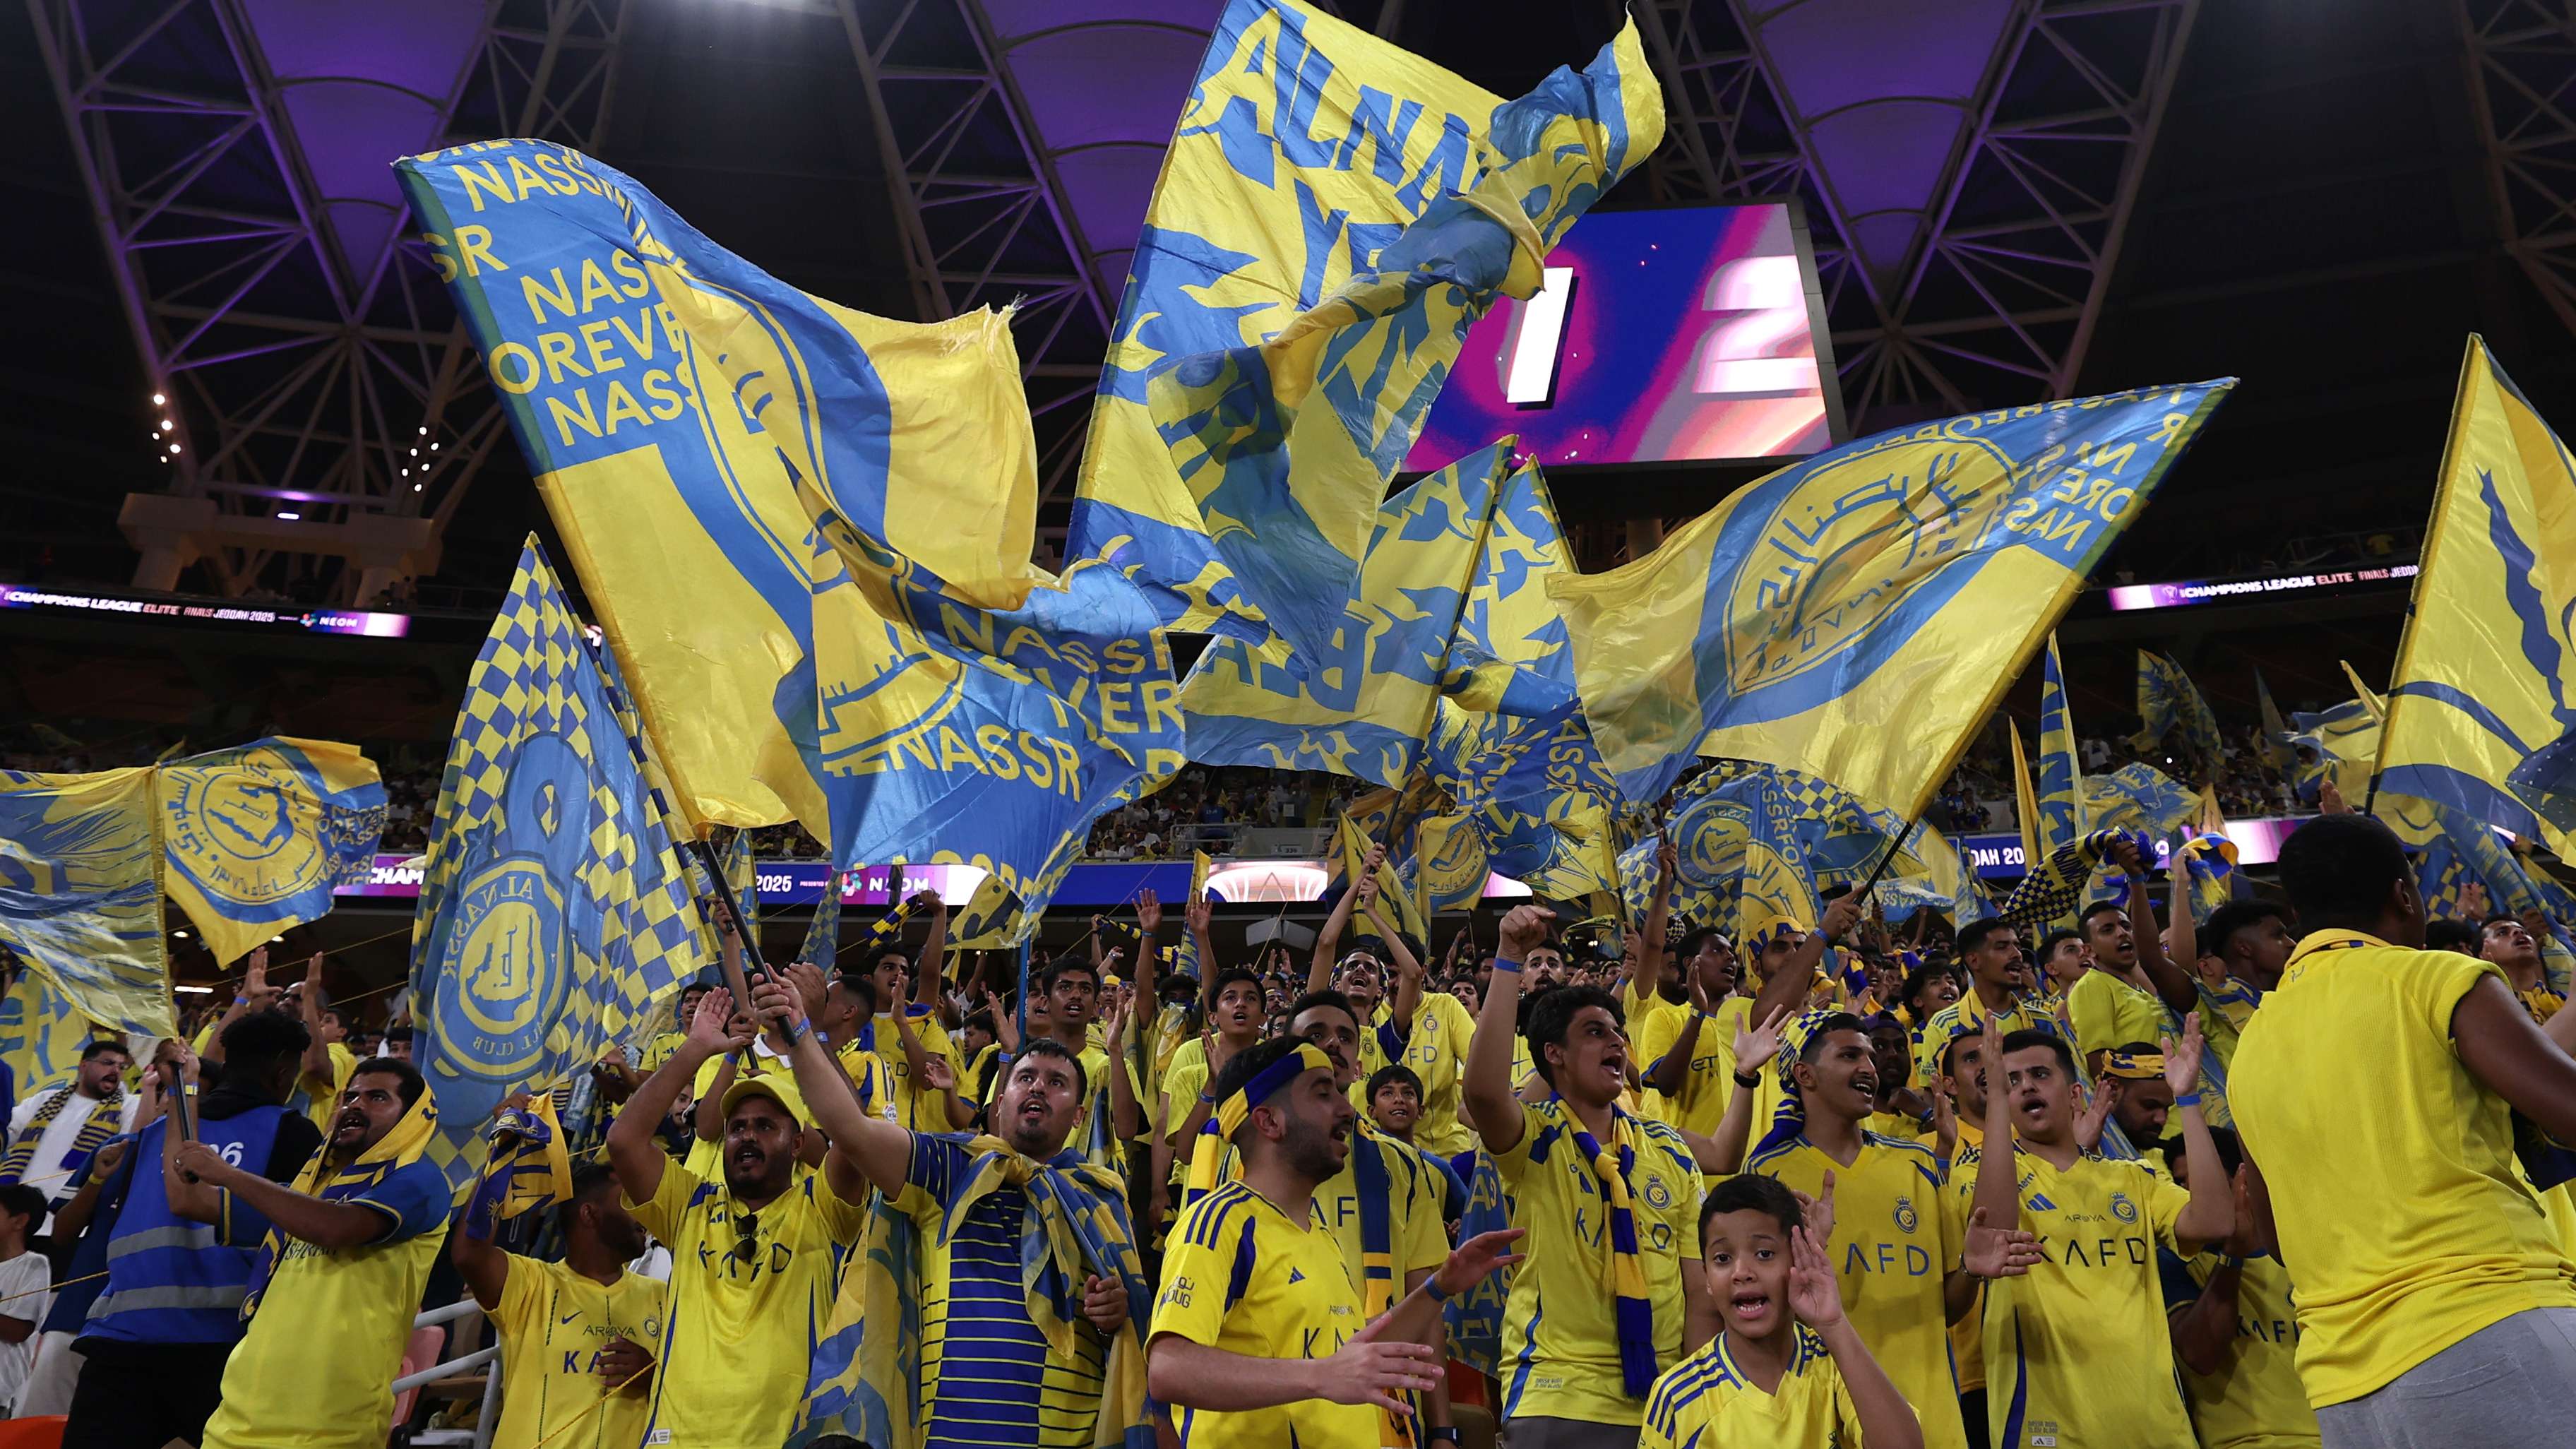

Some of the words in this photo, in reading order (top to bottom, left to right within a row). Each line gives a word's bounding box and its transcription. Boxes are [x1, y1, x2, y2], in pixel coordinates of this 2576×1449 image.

[2185, 581, 2264, 597] CHAMPIONS
[2264, 576, 2316, 591] LEAGUE
[2316, 572, 2354, 585] ELITE
[2359, 568, 2389, 580] FINALS
[8, 590, 91, 607] CHAMPIONS
[90, 598, 143, 613] LEAGUE
[143, 603, 179, 615] ELITE
[184, 606, 213, 617] FINALS
[213, 608, 248, 621] JEDDAH
[249, 611, 276, 623] 2025
[319, 616, 358, 627] NEOM
[888, 724, 1080, 803] NASSR
[756, 876, 792, 893] 2025
[869, 877, 929, 892] NOM
